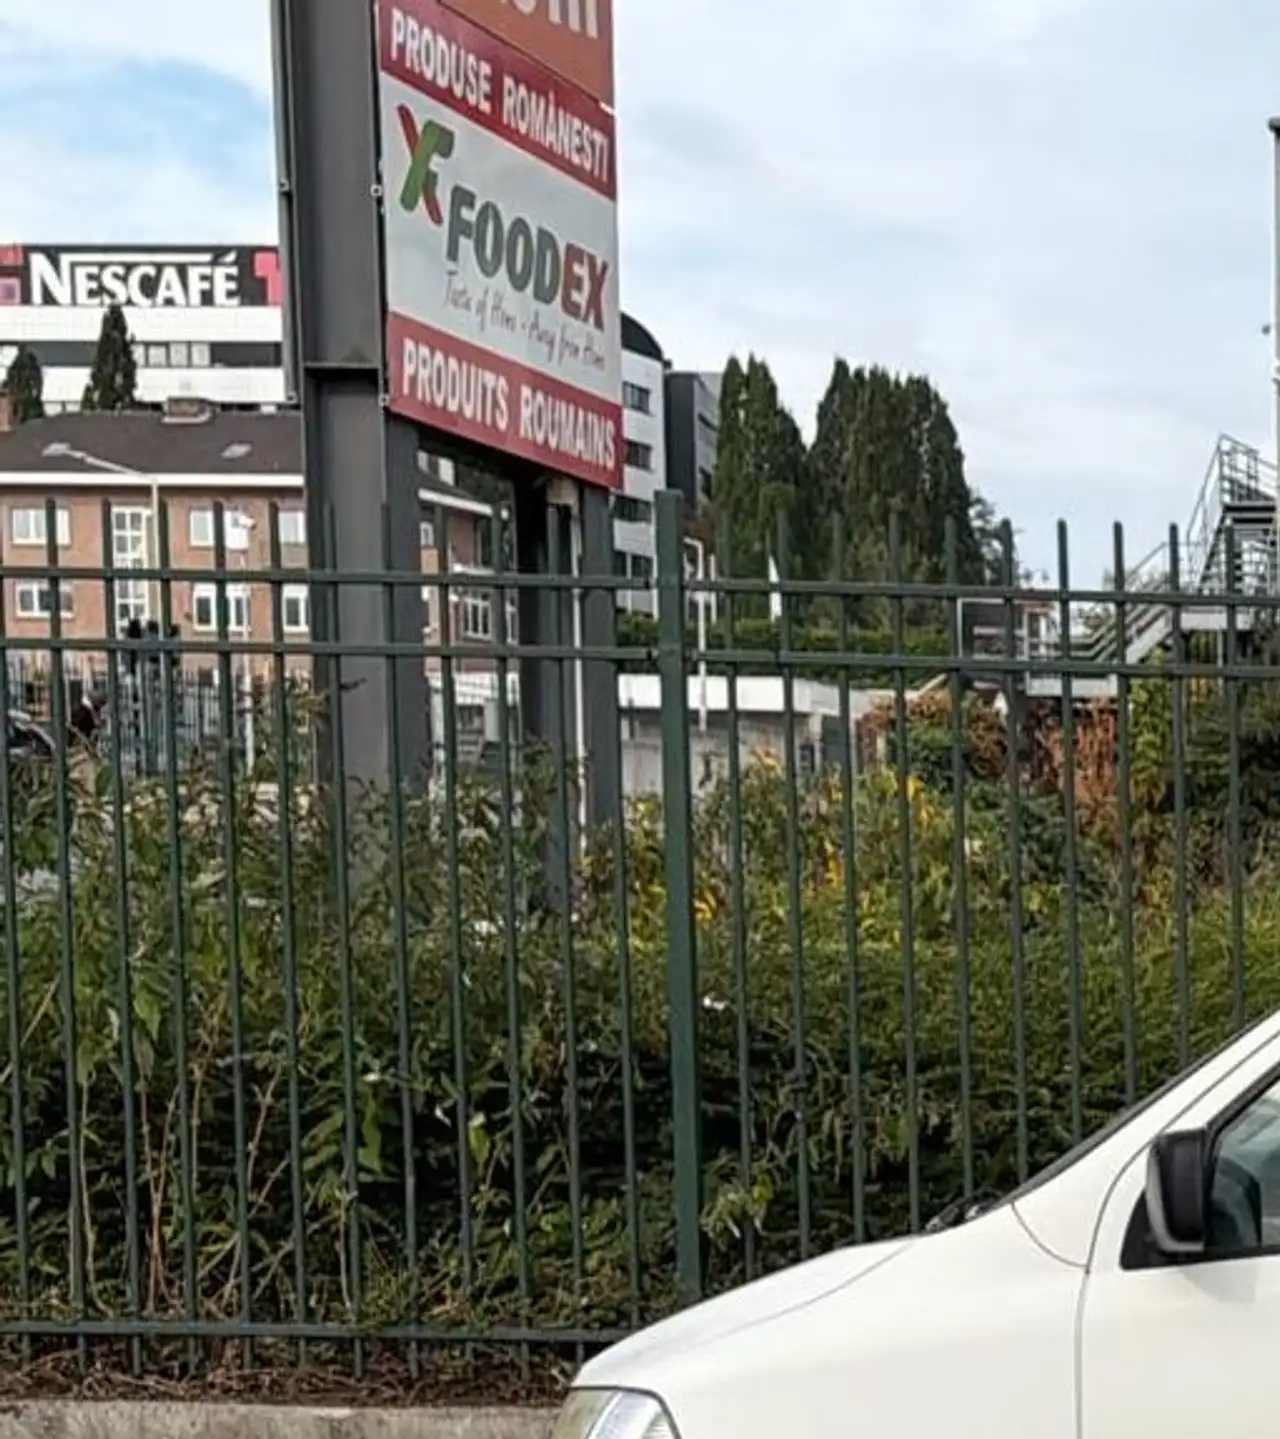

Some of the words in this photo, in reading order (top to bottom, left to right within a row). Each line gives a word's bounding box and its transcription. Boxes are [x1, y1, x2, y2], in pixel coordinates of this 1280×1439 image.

[391, 7, 493, 116] PRODUSE
[446, 184, 608, 334] FOODEX
[402, 337, 509, 433] PRODUITS
[519, 383, 617, 471] ROUMAINS
